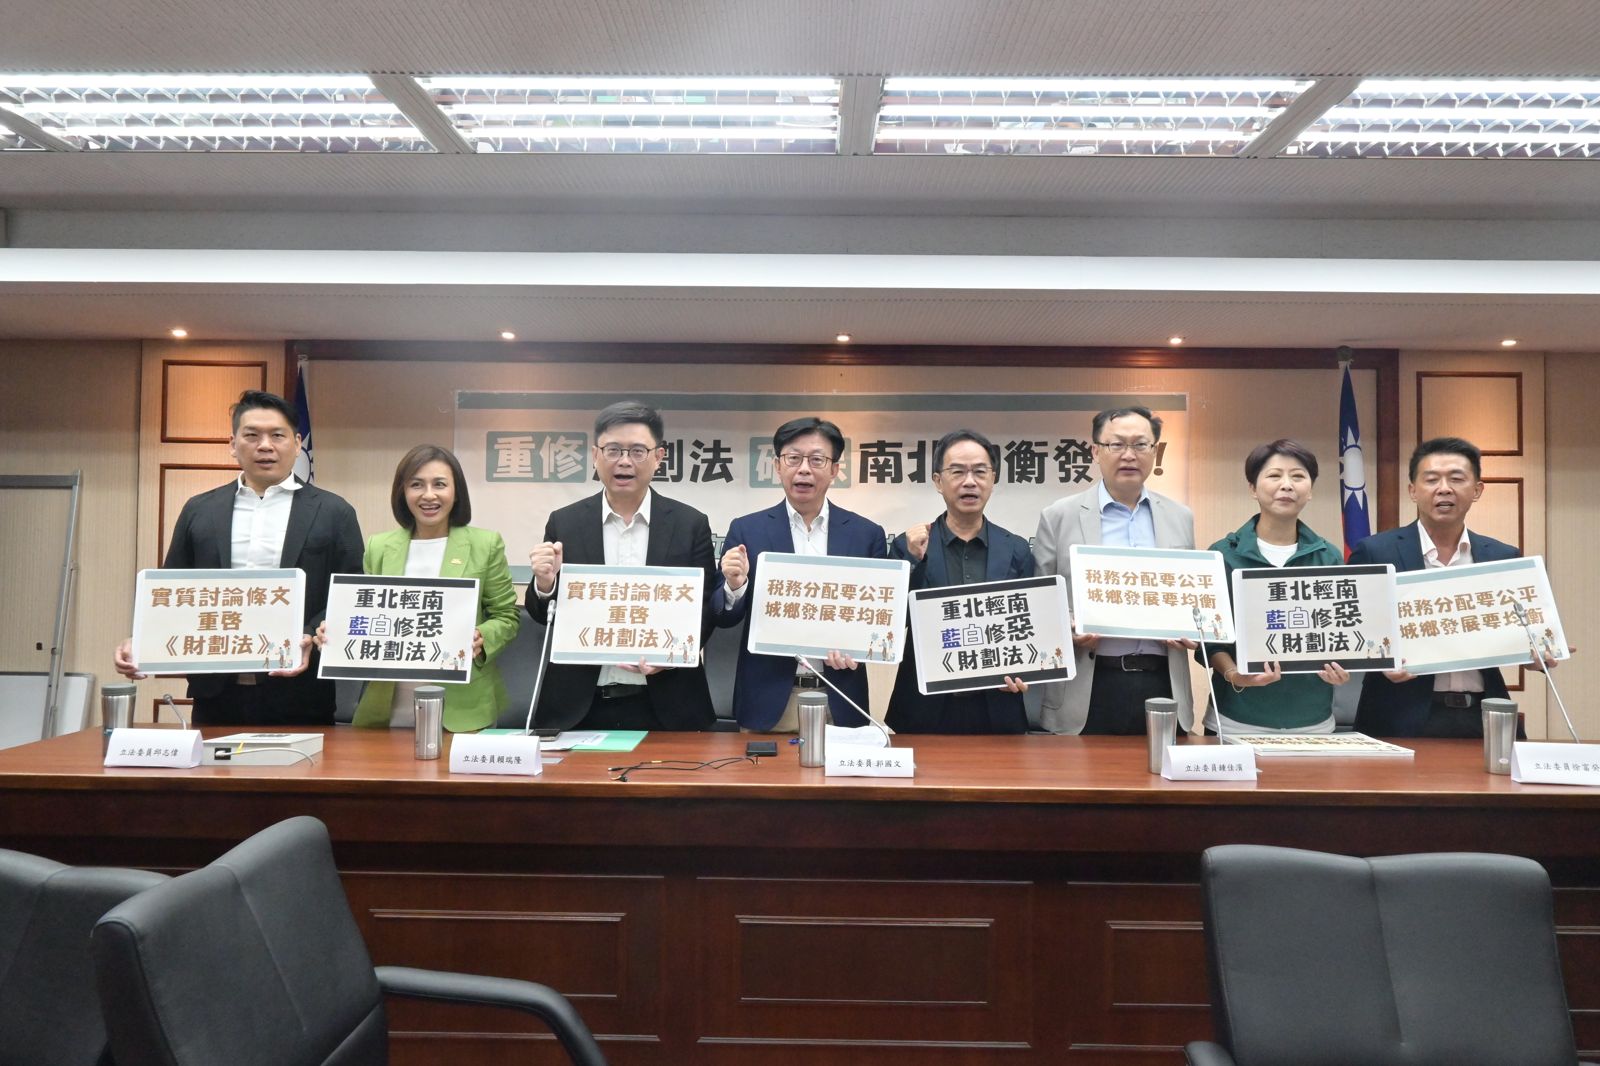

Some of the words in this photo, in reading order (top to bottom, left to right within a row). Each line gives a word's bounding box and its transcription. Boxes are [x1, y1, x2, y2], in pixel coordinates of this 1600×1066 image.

[151, 586, 290, 607] 實質討論條文
[355, 588, 444, 610] 重北輕南
[567, 581, 694, 602] 實質討論條文
[1087, 587, 1217, 609] 城鄉發展要均衡
[1268, 578, 1358, 602] 重北輕南
[765, 600, 894, 627] 城鄉發展要均衡
[941, 592, 1029, 621] 重北輕南
[1265, 599, 1363, 630] 藍白修惡
[347, 611, 443, 638] 藍白修惡
[940, 613, 1035, 649] 藍白修惡
[165, 633, 270, 656] 《財劃法》
[578, 627, 674, 649] 《財劃法》
[1265, 630, 1366, 655] 《財劃法》
[344, 639, 442, 662] 《財劃法》
[942, 643, 1038, 673] 《財劃法》
